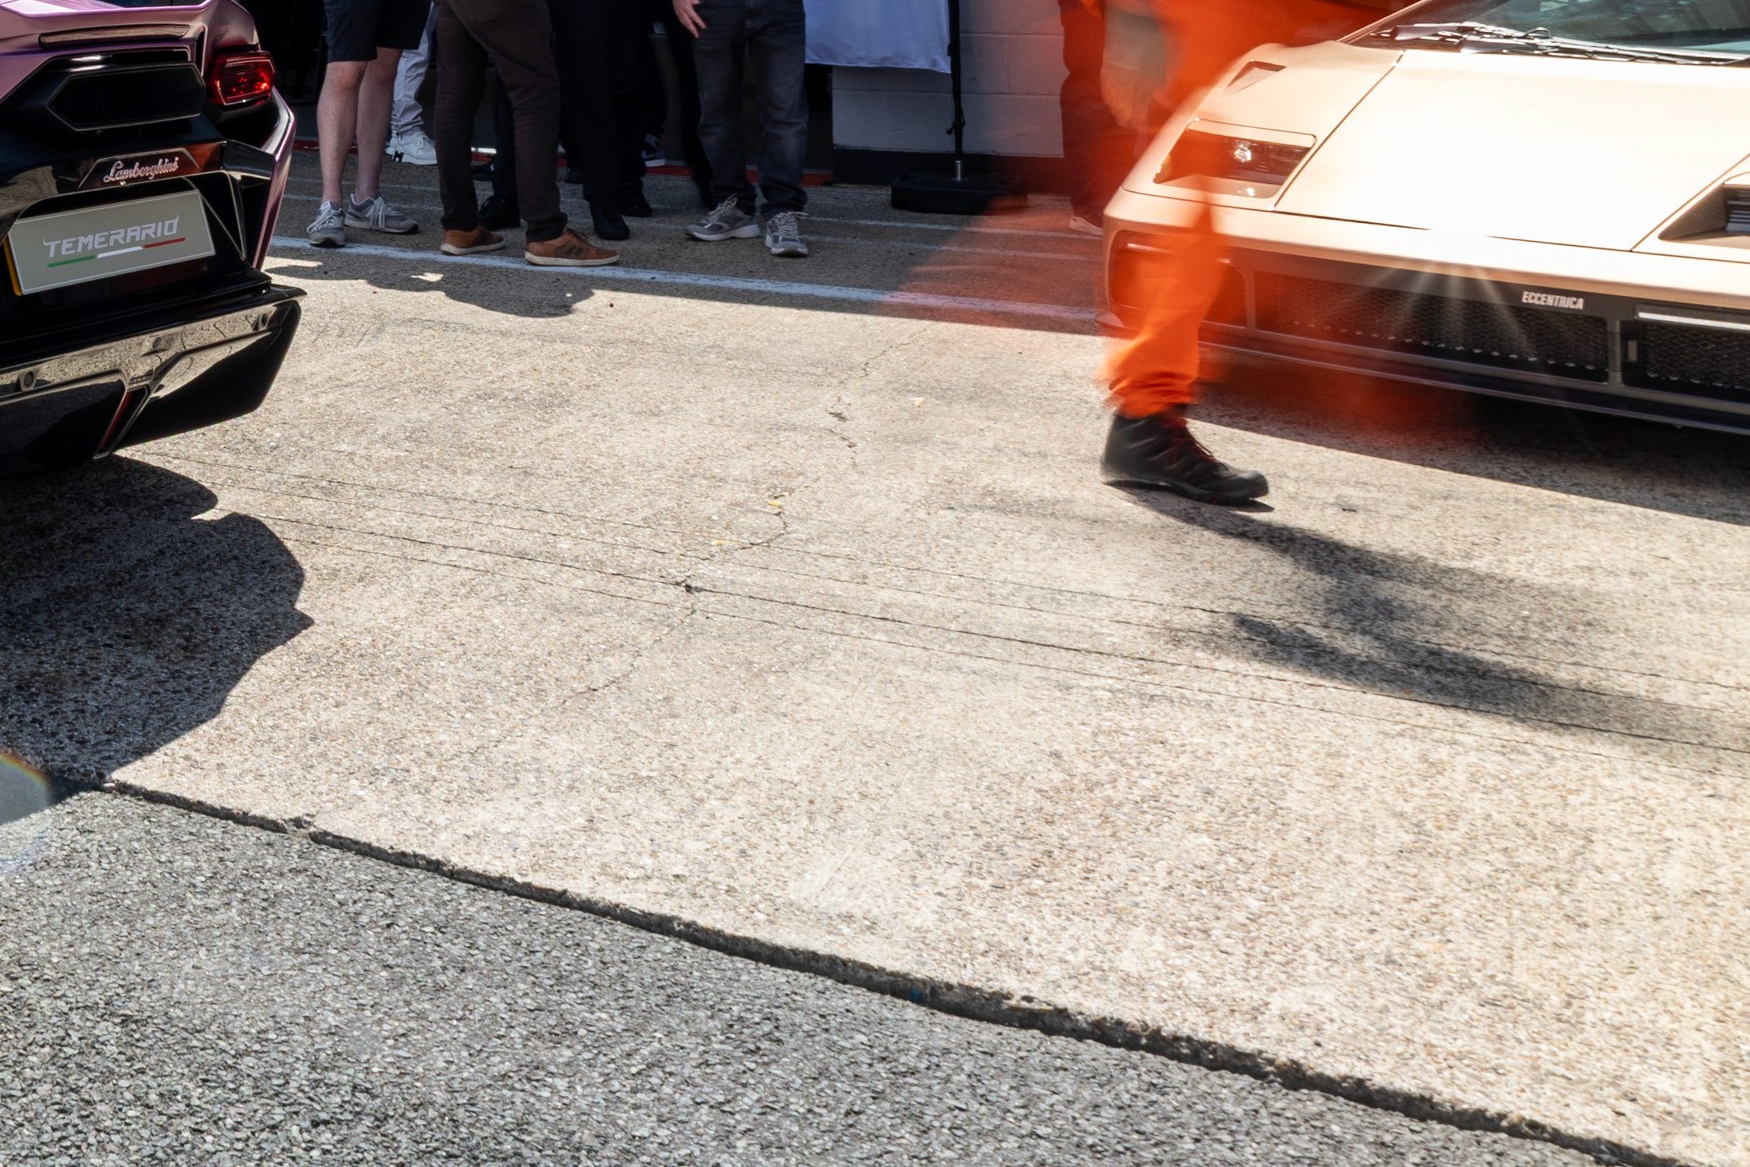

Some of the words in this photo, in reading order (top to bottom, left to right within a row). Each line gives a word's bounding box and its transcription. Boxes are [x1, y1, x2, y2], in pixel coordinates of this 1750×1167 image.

[103, 156, 179, 183] Lamborghini
[43, 214, 180, 259] TEMERARIO
[1522, 291, 1584, 310] ECCENTRICA
